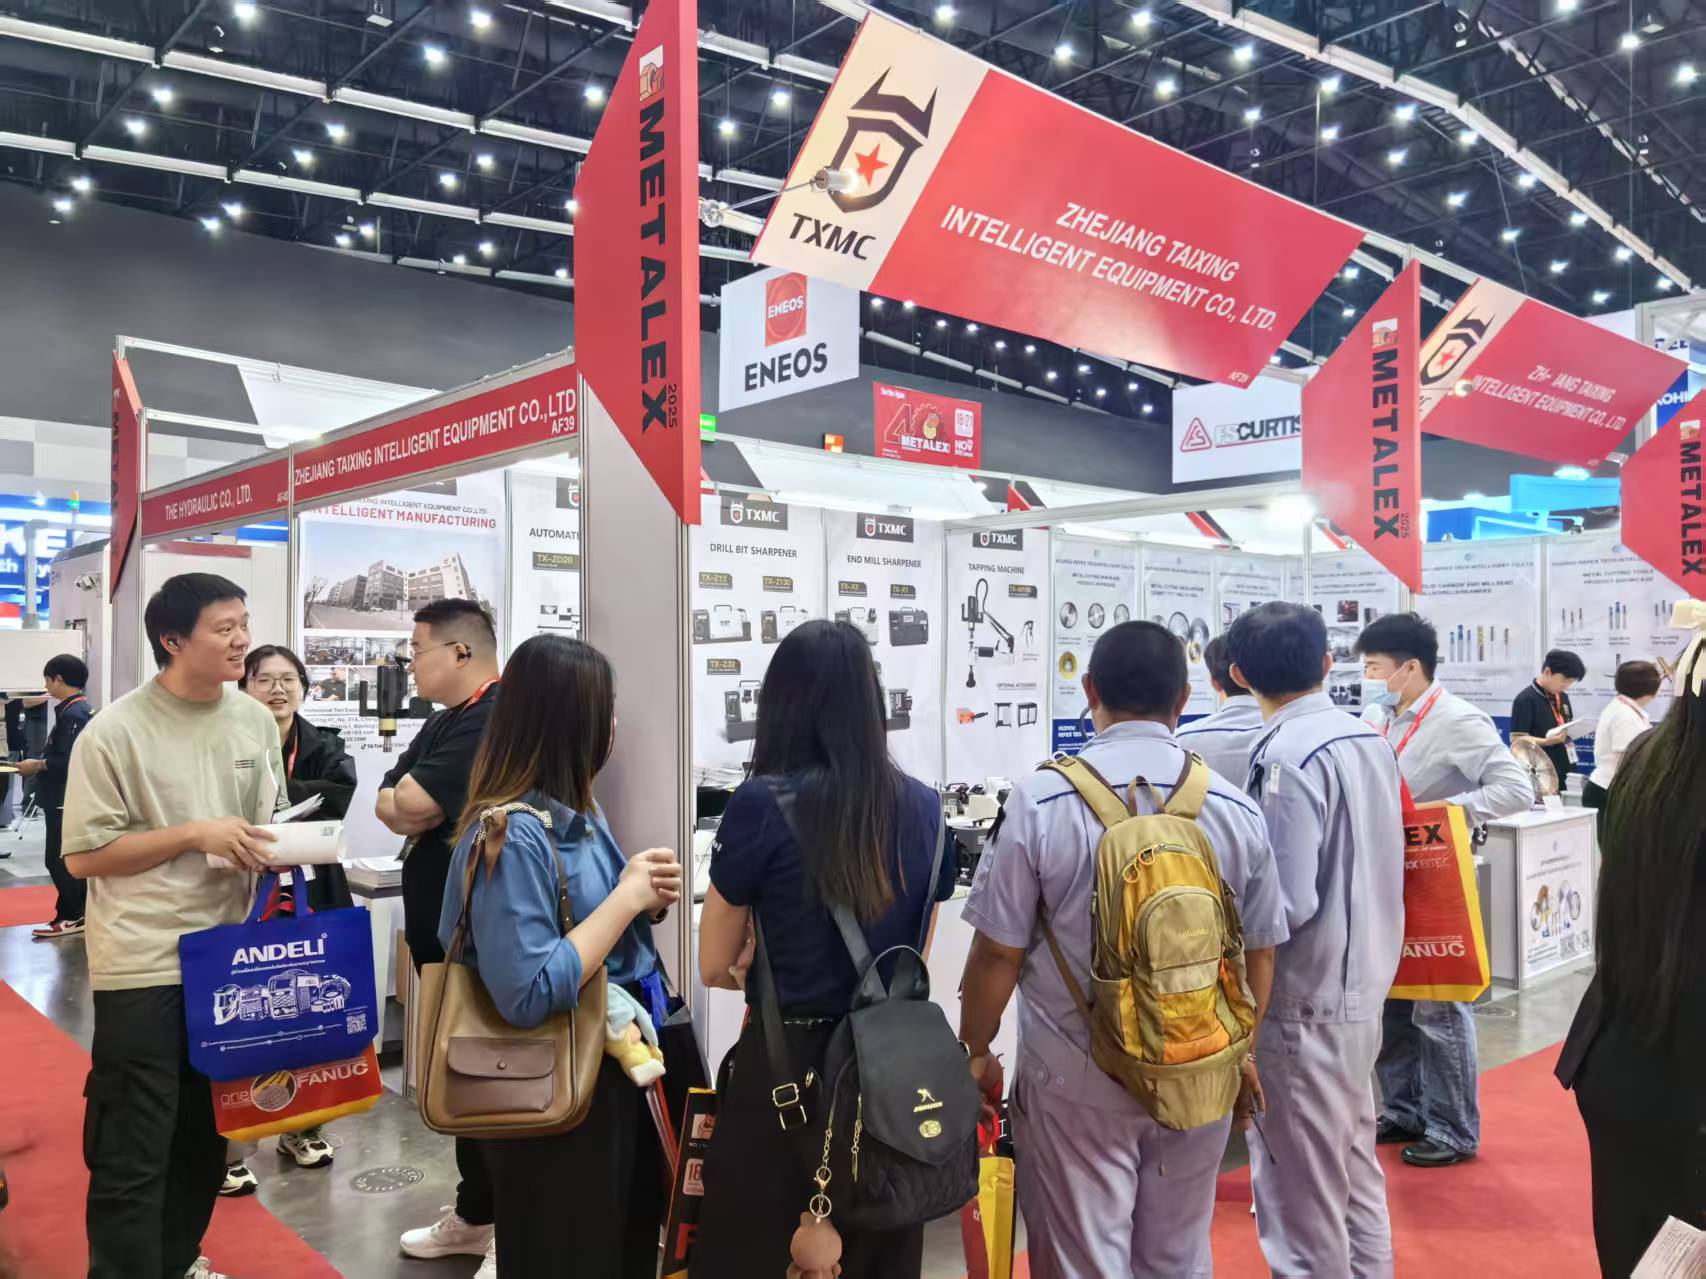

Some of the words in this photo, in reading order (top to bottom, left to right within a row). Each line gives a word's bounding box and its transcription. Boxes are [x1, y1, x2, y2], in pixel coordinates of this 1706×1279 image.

[789, 212, 876, 261] TXMC
[1056, 201, 1166, 257] ZHEJIANG
[1165, 240, 1240, 283] TAIXING
[638, 96, 667, 433] METALEX
[940, 204, 1096, 273] INTELLIGENT
[1092, 255, 1209, 309] EQUIPMENT
[1240, 304, 1277, 332] LTD.
[767, 295, 804, 319] ENEOS
[744, 342, 828, 392] ENEOS
[667, 383, 678, 428] 2025
[1534, 394, 1594, 421] EQUIPMENT
[551, 415, 575, 435] AF39
[295, 459, 336, 486] ZHEJIANG
[336, 451, 372, 476] TAIXING
[374, 428, 441, 466] INTELLIGENT
[444, 406, 516, 446] EQUIPMENT
[900, 435, 950, 454] METALEX
[1372, 348, 1400, 540] METALEX
[165, 504, 178, 521] THE
[179, 492, 218, 517] HYDRAULIC
[236, 484, 252, 506] LTD.
[746, 508, 780, 523] TXMC
[1680, 441, 1703, 577] METALEX
[396, 511, 496, 529] MANUFACTURING
[877, 523, 908, 536] TXMC
[1400, 511, 1410, 539] 2025
[710, 543, 734, 554] DRILL
[736, 545, 749, 554] BIT
[751, 546, 798, 558] SHARPENER
[991, 532, 1017, 545] TXMC
[847, 554, 862, 564] END
[864, 556, 880, 565] MILL
[882, 558, 922, 568] SHARPENER
[968, 564, 996, 573] TAPPING
[997, 565, 1025, 574] MACHINE
[231, 938, 325, 966] ANDELI
[296, 1061, 369, 1089] FANUC
